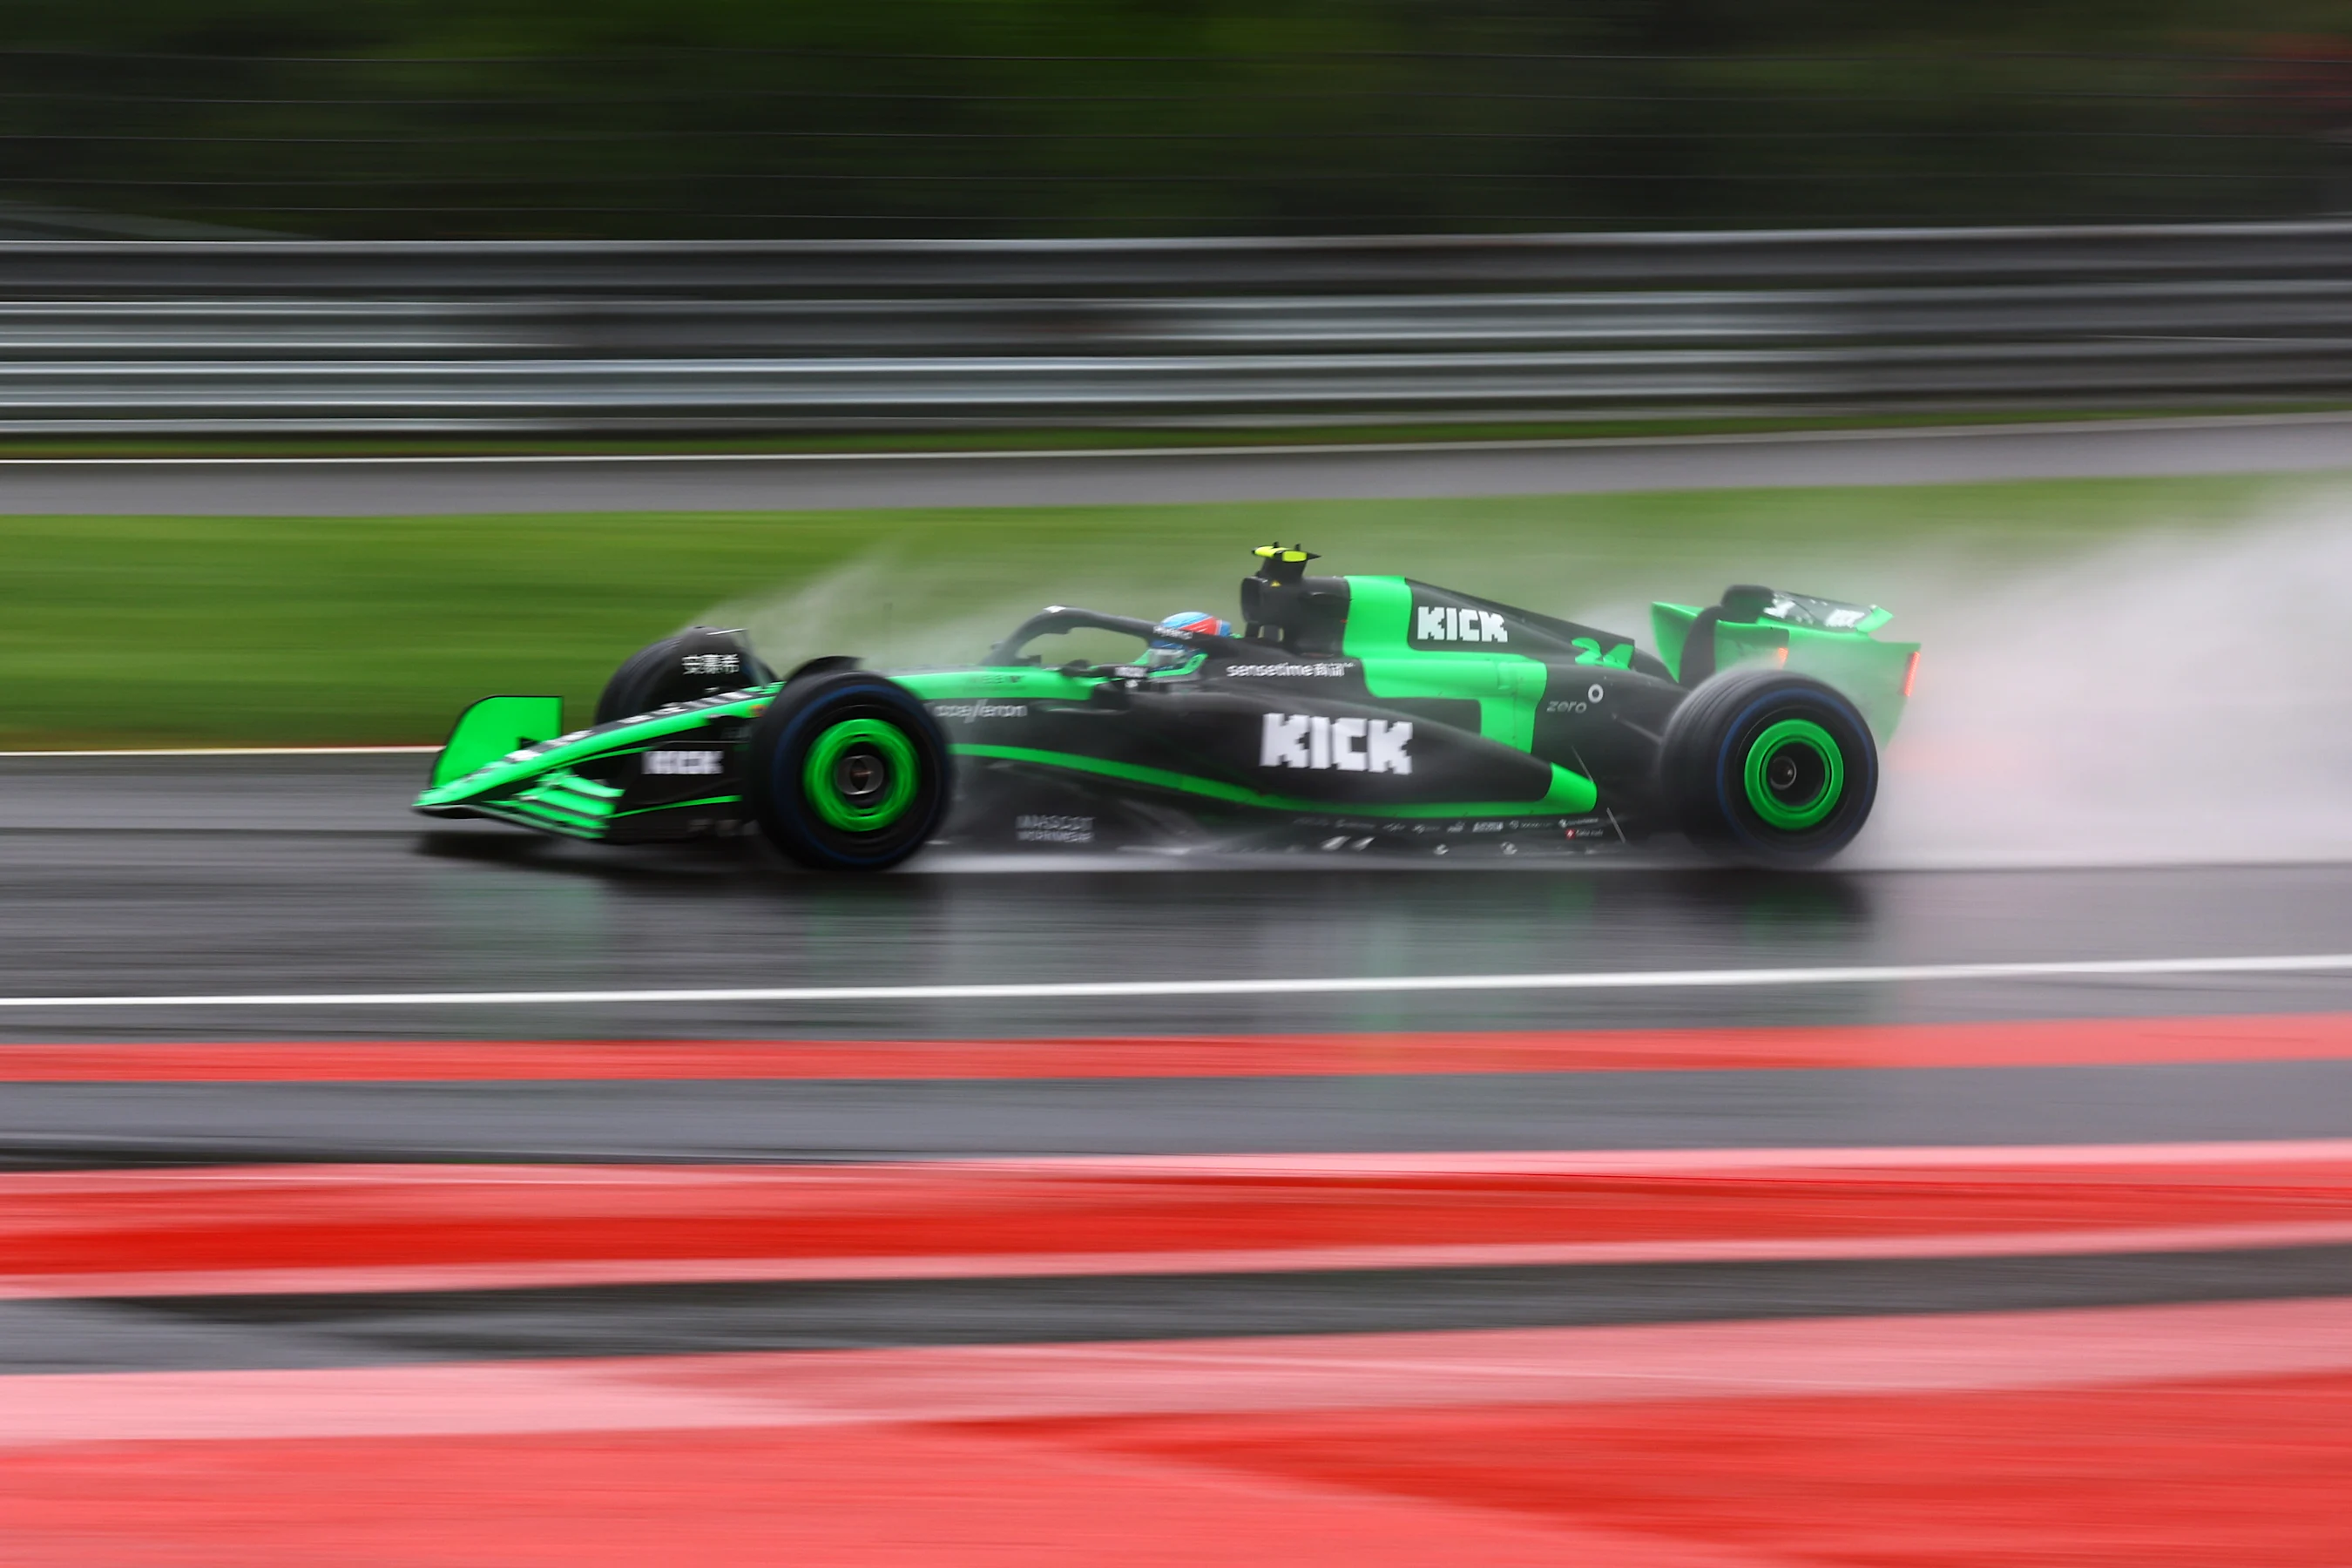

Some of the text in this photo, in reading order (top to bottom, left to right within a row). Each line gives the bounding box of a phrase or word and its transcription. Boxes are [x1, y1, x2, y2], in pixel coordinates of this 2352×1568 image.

[1417, 605, 1509, 643] KICK
[1226, 661, 1314, 677] sensetime
[1259, 713, 1413, 775] KICK
